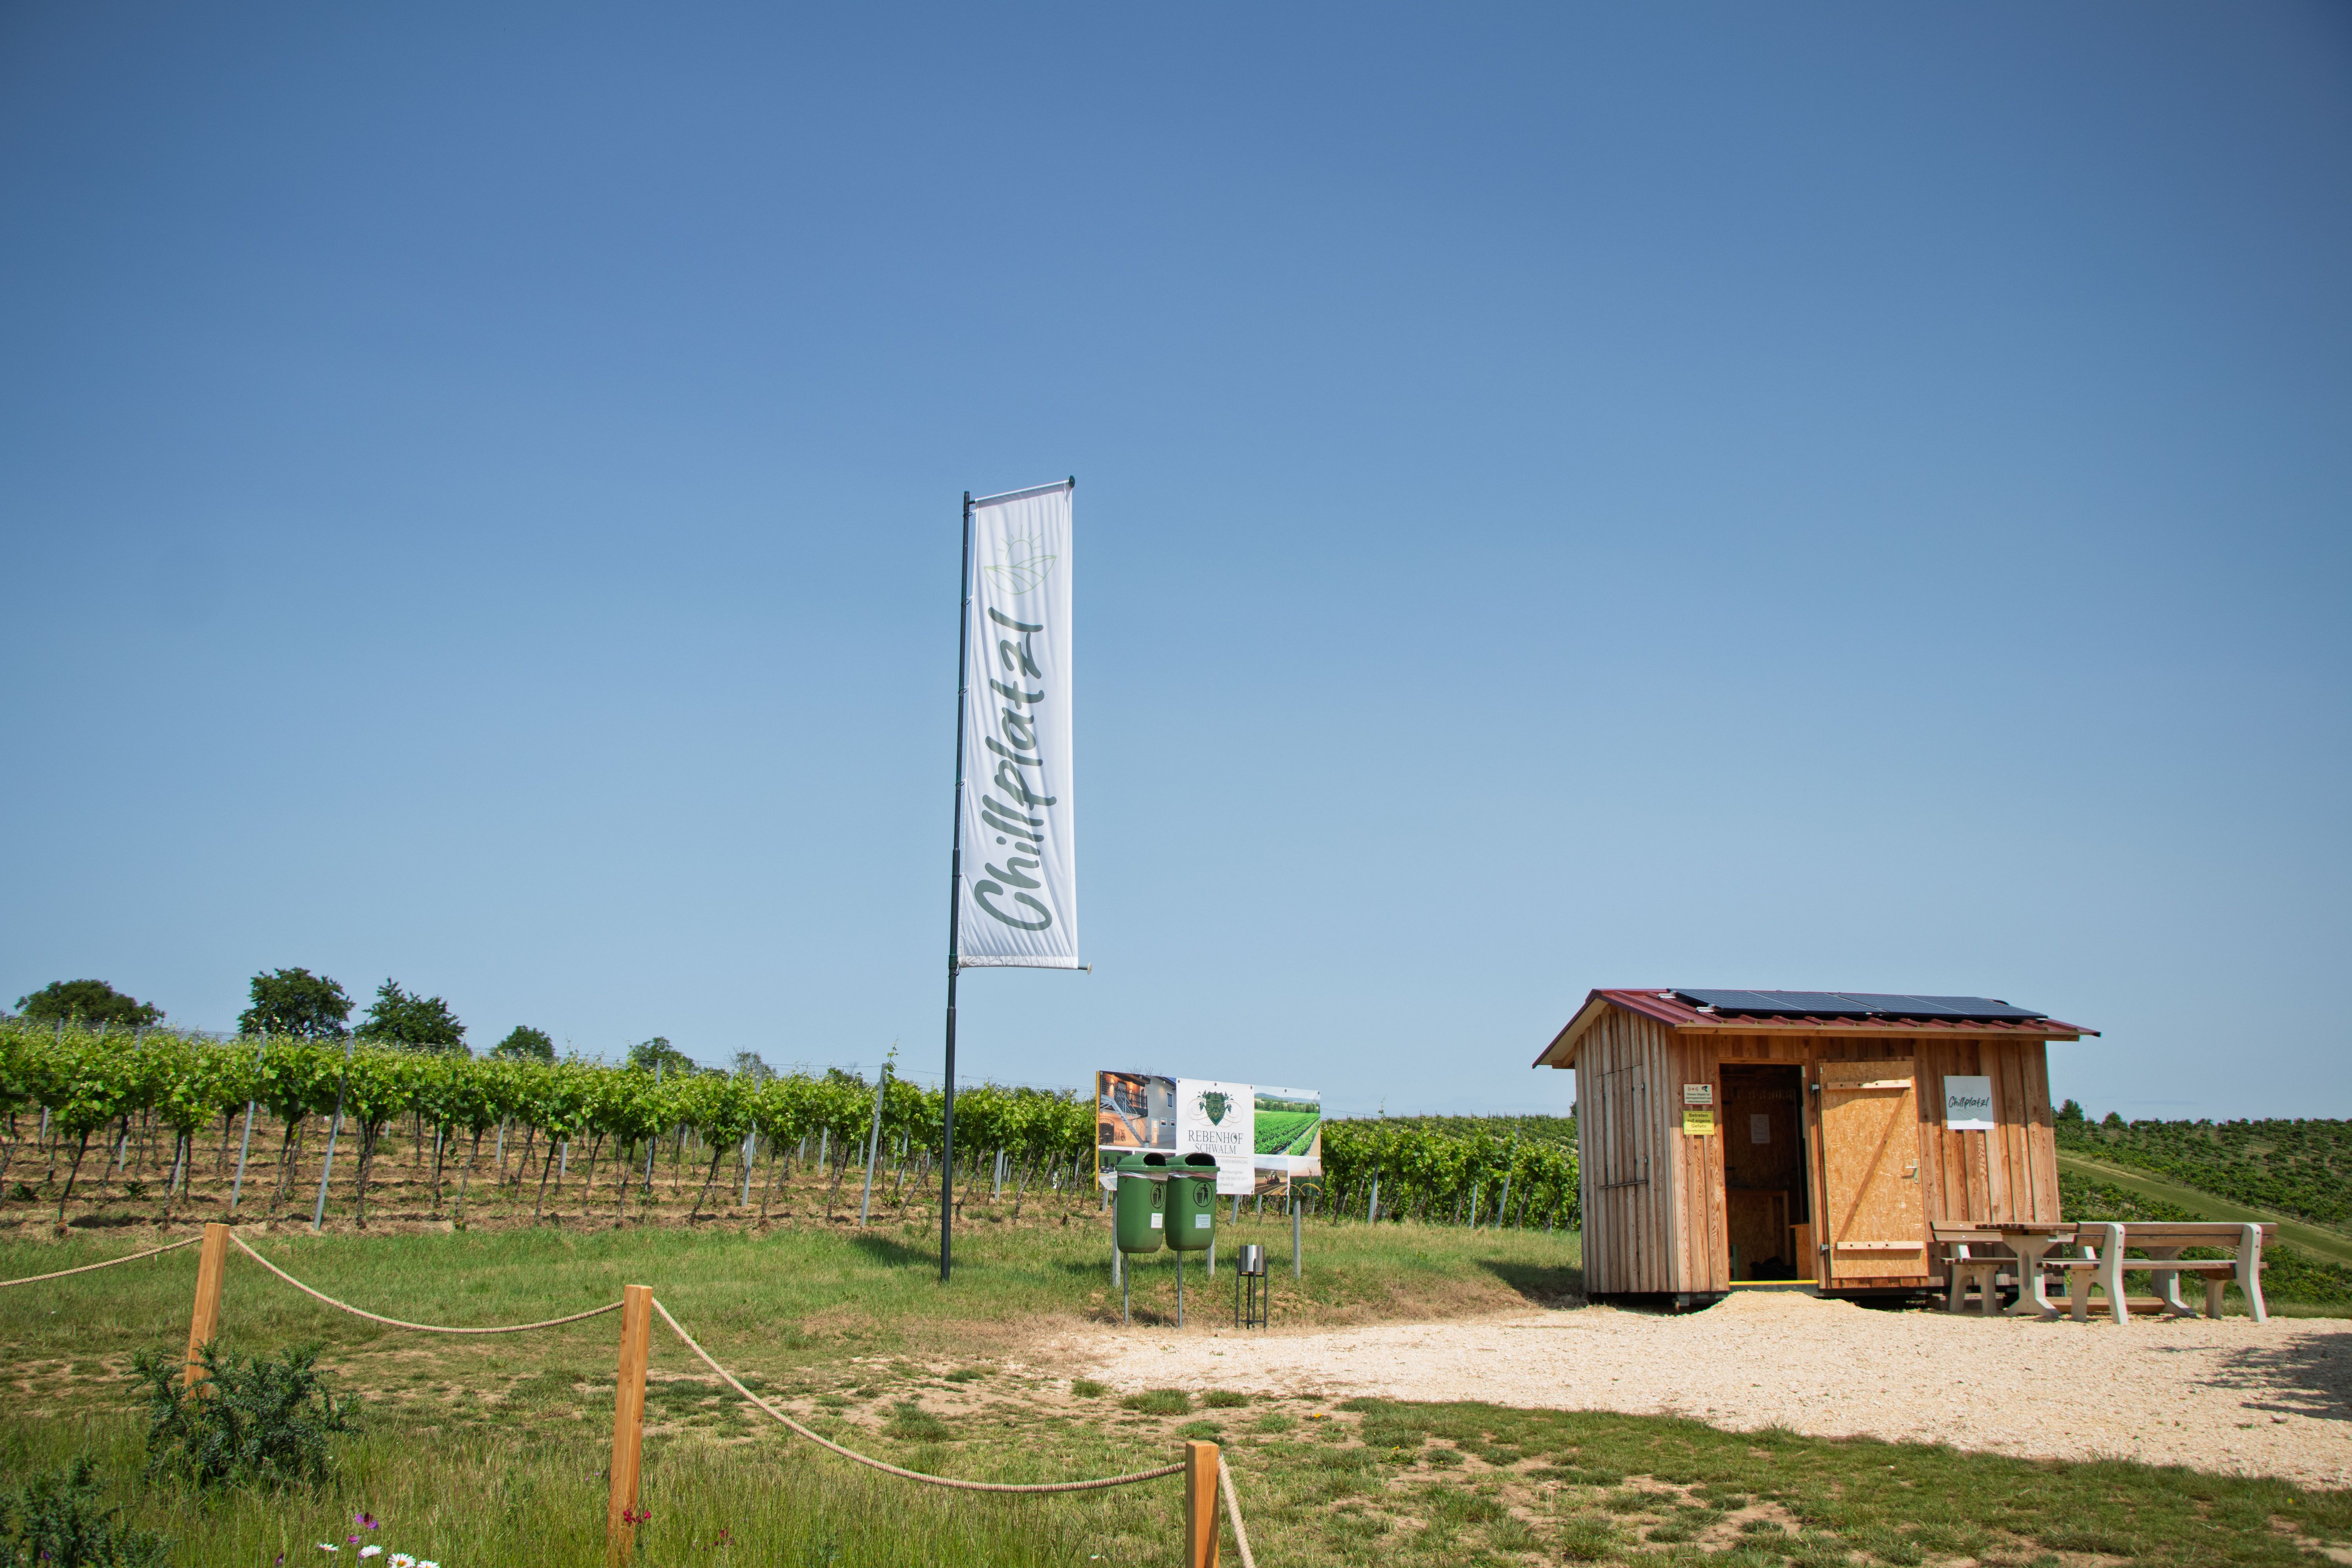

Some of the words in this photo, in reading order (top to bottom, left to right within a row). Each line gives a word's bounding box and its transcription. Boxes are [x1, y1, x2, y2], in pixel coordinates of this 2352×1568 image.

[974, 606, 1057, 931] Chillplatzl
[1949, 1096, 1989, 1109] Chillplatzl
[1188, 1130, 1243, 1144] REBENHOF
[1196, 1143, 1236, 1154] SCHWALM
